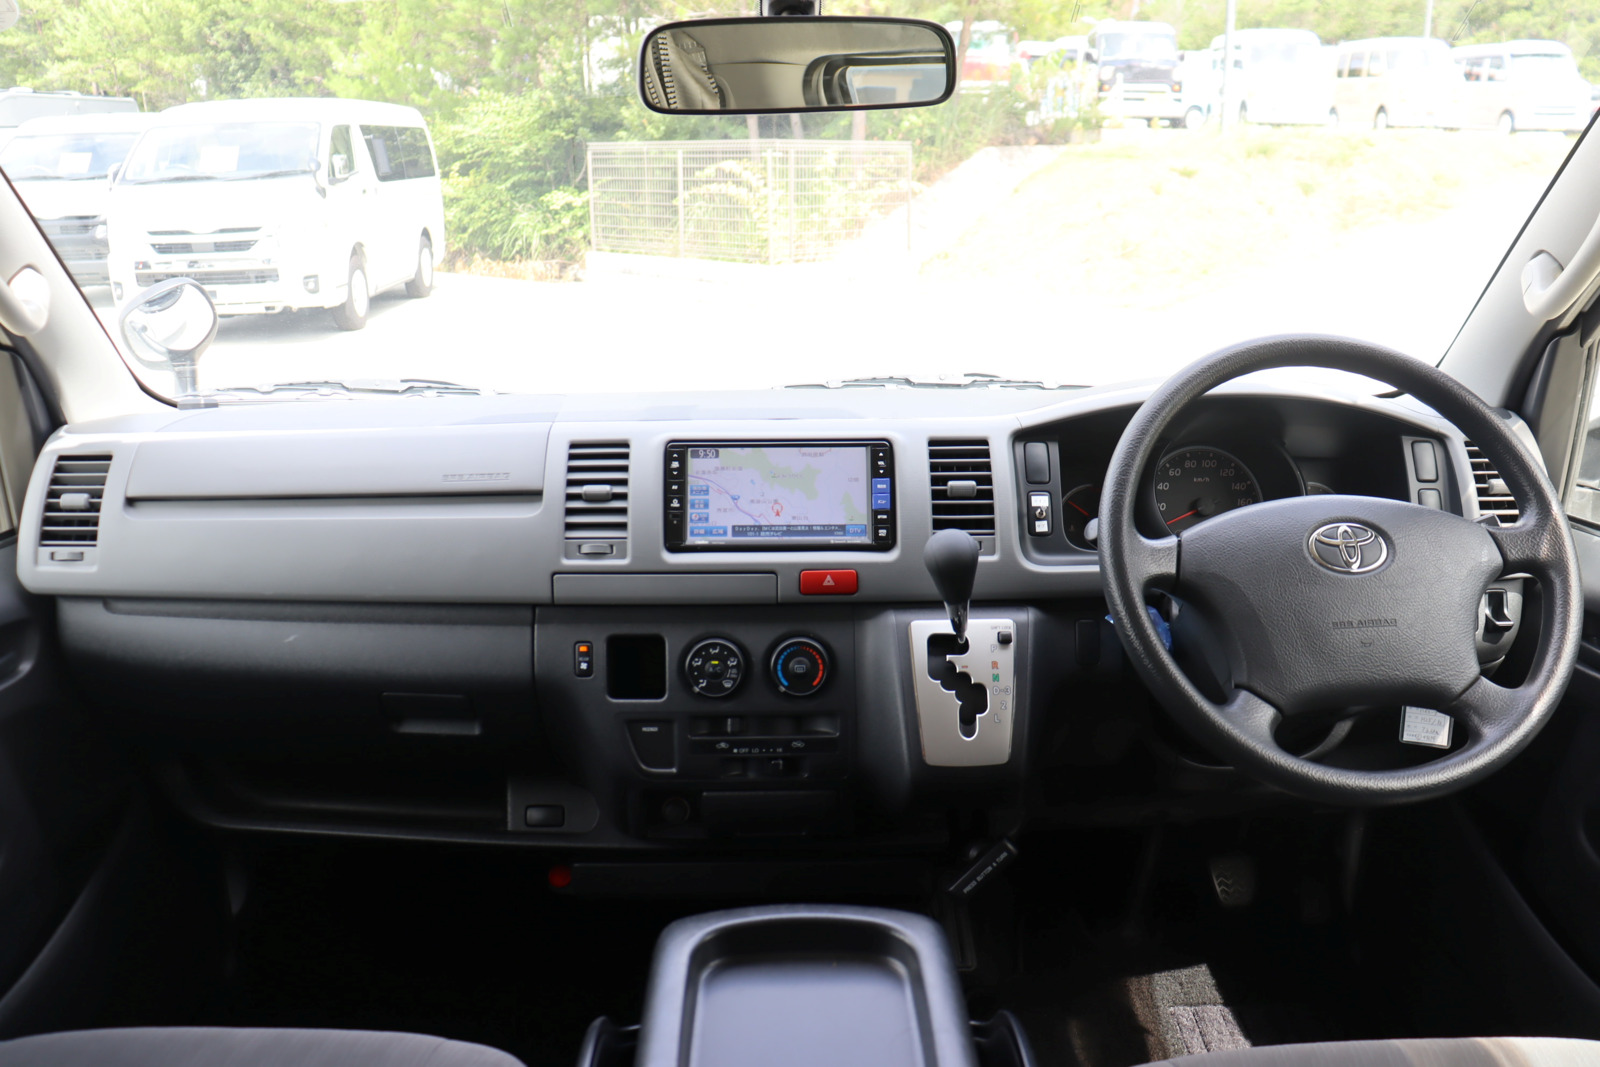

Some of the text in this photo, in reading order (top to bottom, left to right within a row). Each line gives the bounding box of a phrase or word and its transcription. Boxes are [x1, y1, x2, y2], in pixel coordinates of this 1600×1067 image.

[698, 450, 716, 458] 9:50
[1184, 460, 1197, 468] 80
[1201, 460, 1217, 468] 100
[1168, 468, 1181, 476] 60
[1220, 468, 1235, 477] 120
[1157, 482, 1169, 491] 40
[1231, 482, 1247, 491] 140
[1357, 618, 1397, 627] AIRBAG
[991, 644, 998, 653] P
[991, 661, 999, 670] R
[992, 673, 1000, 682] N
[1001, 701, 1007, 710] 2
[994, 714, 1000, 723] L
[976, 865, 993, 882] BUTTON
